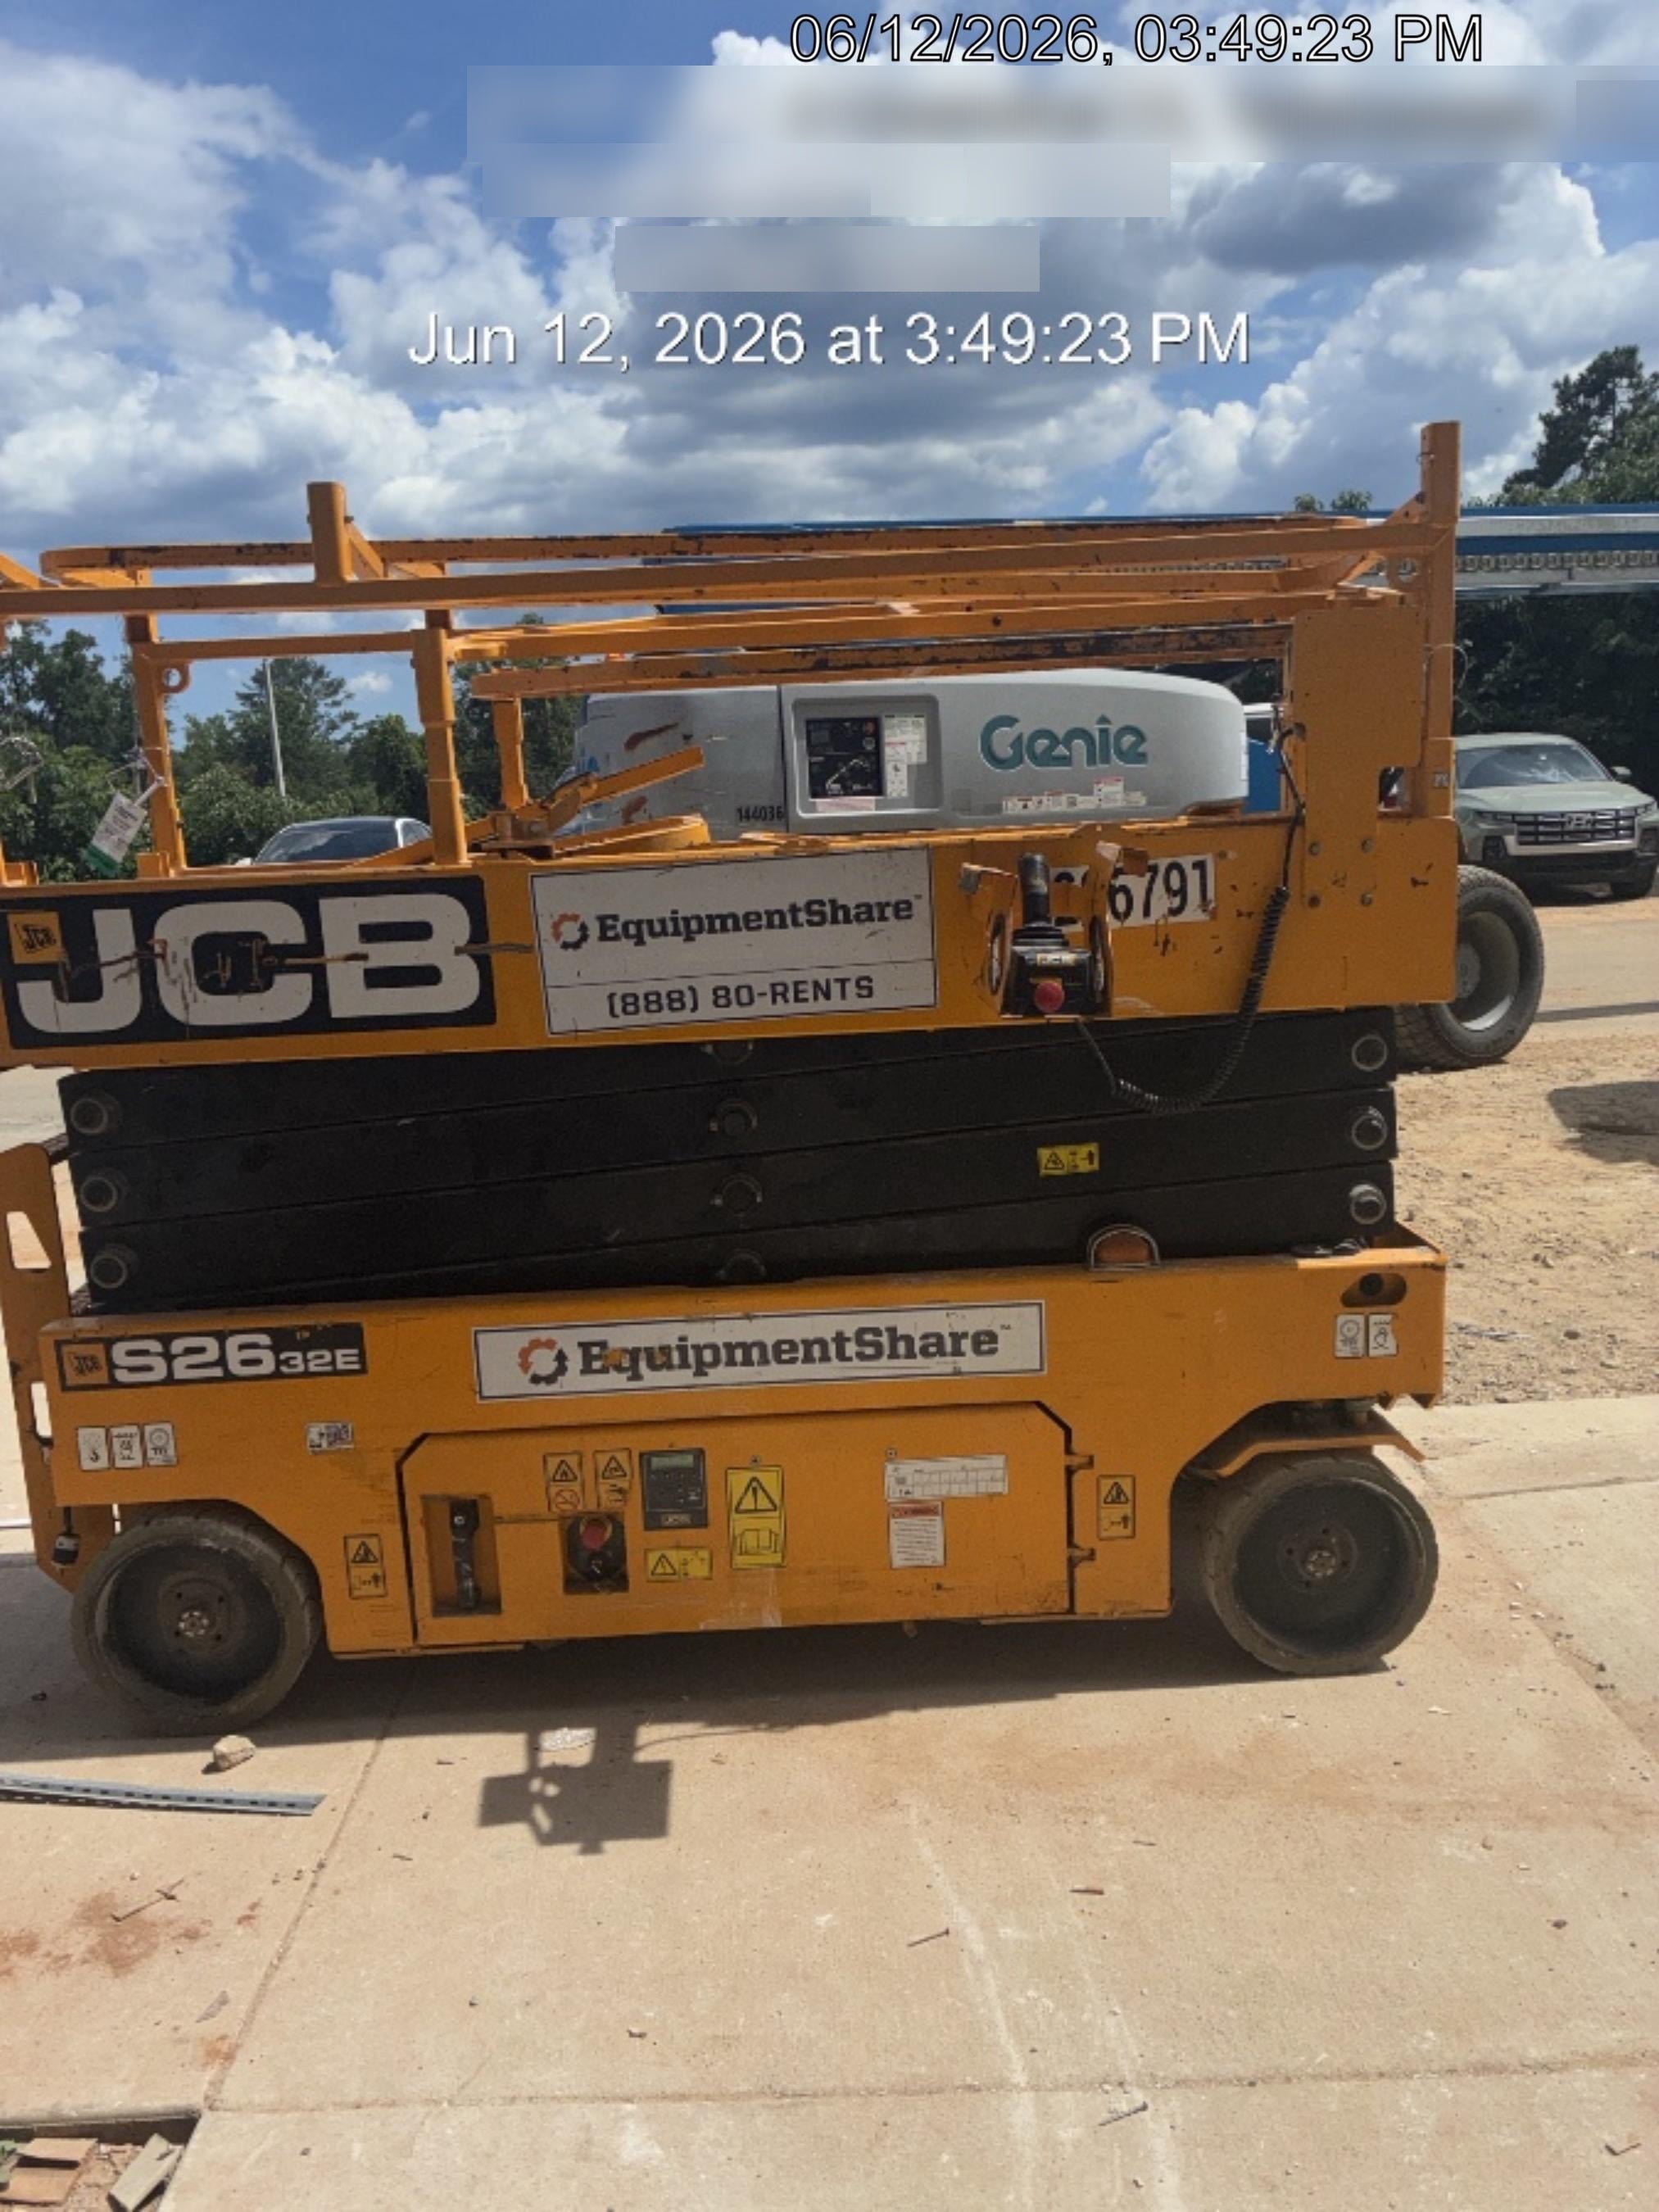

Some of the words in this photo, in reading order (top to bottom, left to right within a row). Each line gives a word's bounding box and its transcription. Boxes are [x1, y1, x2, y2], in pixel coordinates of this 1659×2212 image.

[981, 714, 1149, 772] Genie
[16, 893, 481, 1034] JCB
[607, 985, 700, 1018] (888)
[712, 975, 875, 1008] 80-RENTS
